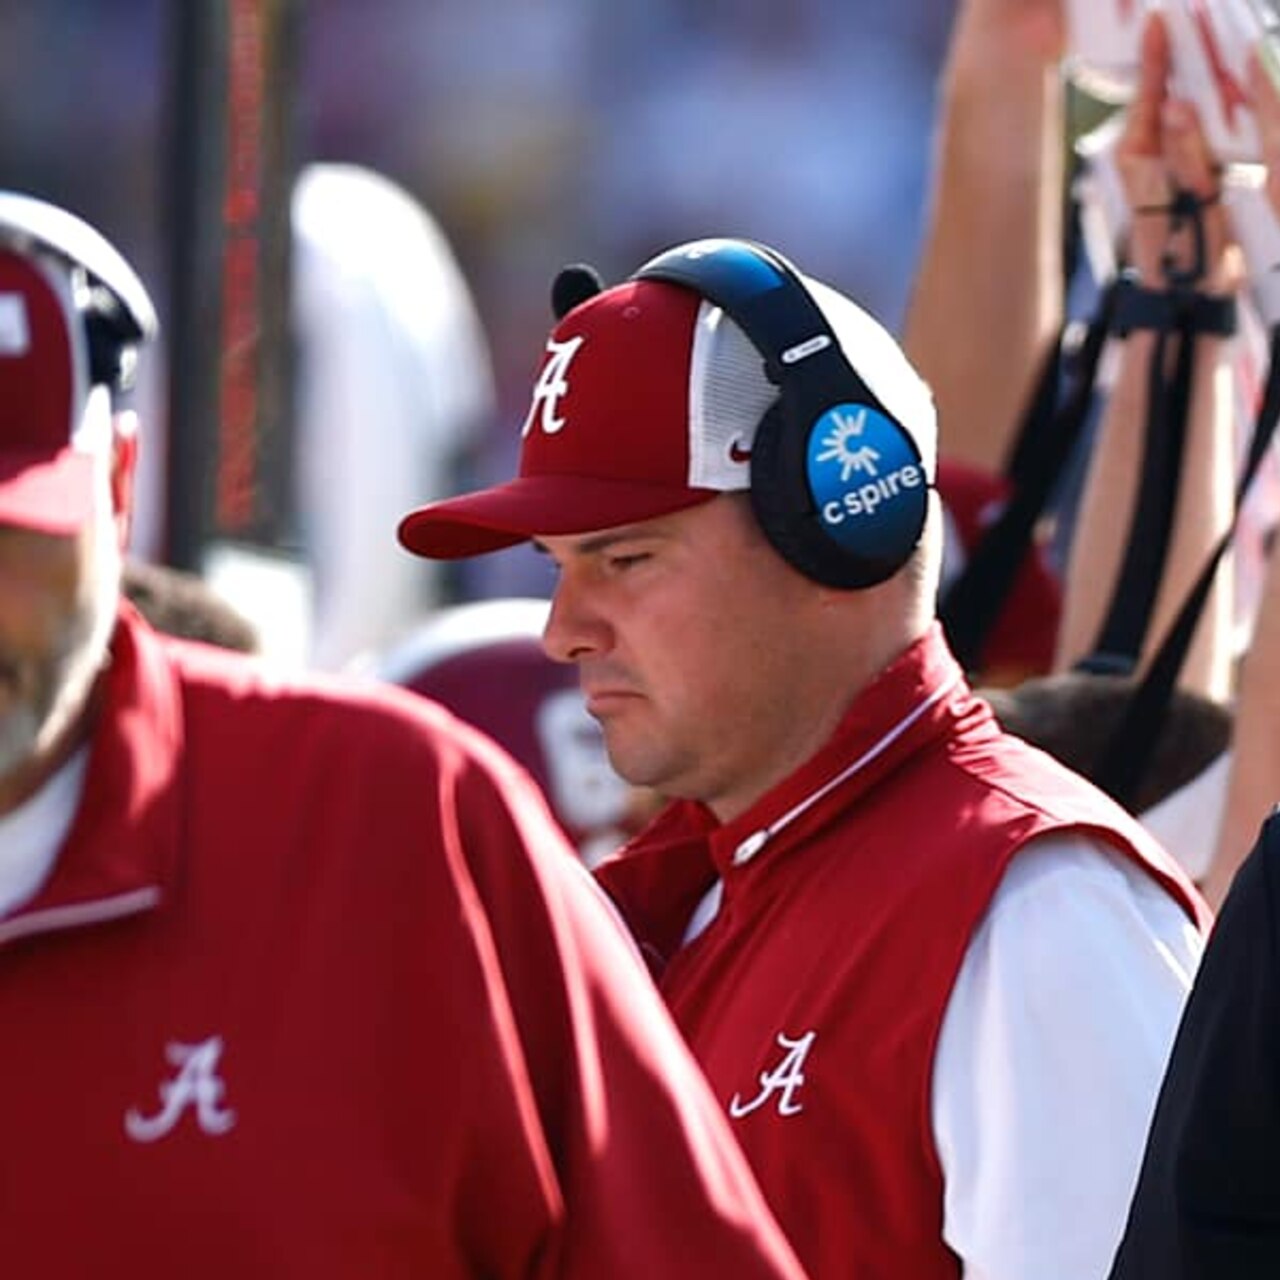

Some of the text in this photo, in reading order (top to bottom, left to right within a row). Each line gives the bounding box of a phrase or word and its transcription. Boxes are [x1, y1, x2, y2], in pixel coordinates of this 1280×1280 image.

[521, 335, 584, 438] A
[845, 466, 922, 517] spire
[124, 1034, 235, 1144] A
[730, 1029, 818, 1119] A
